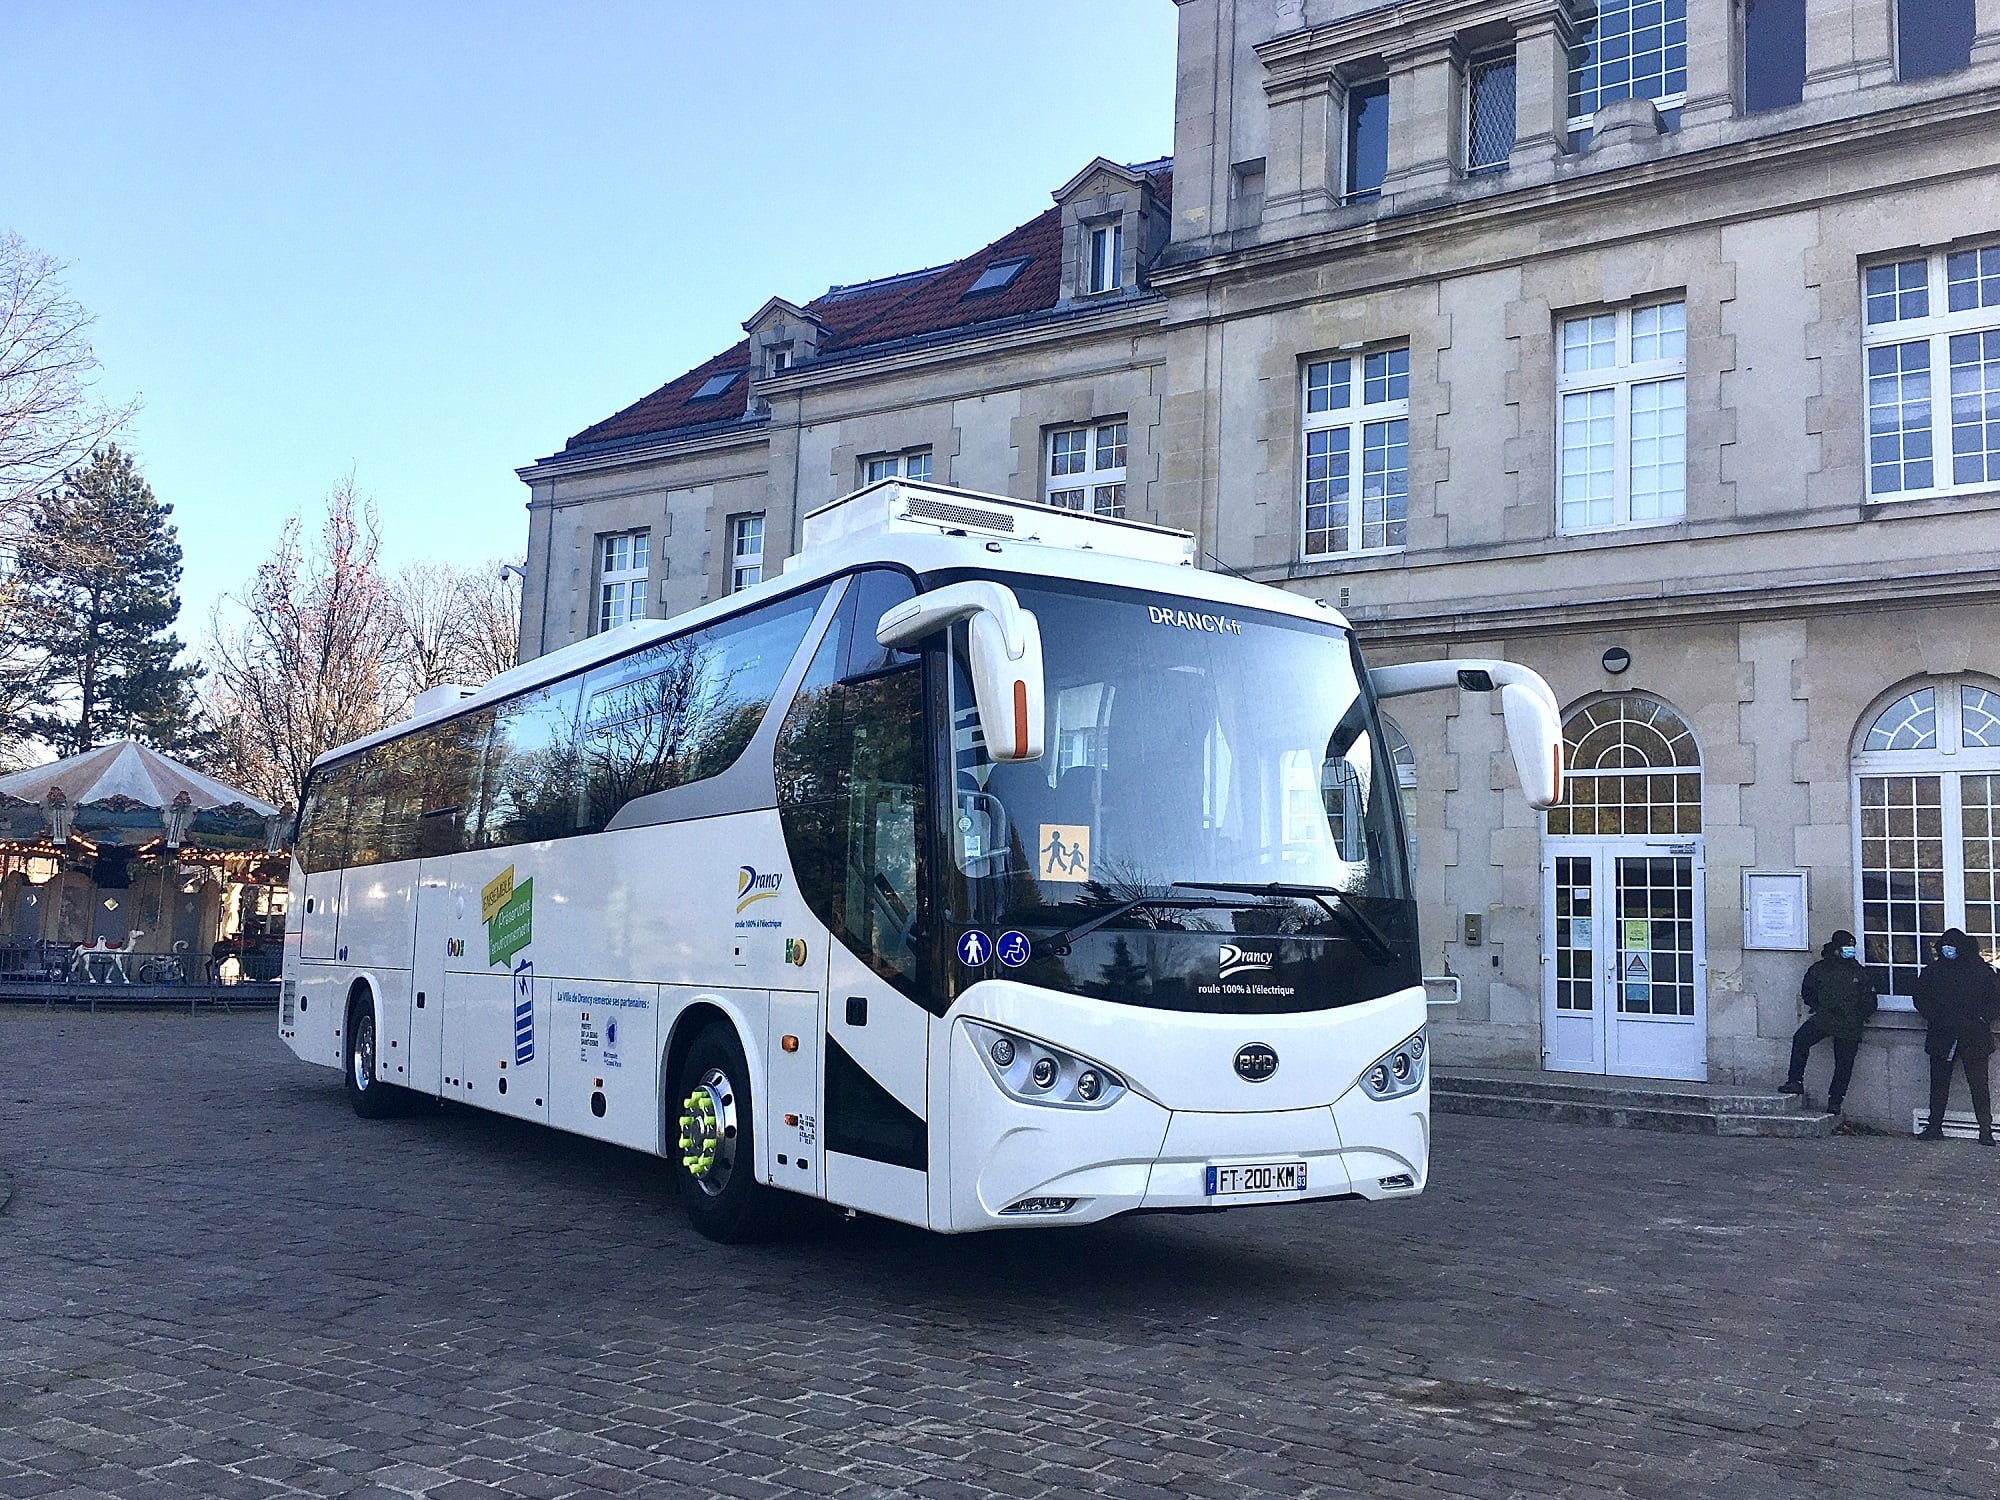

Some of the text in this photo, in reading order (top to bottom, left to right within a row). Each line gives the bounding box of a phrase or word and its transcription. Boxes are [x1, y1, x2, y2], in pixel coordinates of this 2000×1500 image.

[737, 865, 783, 899] Drancy
[1219, 944, 1273, 969] Drancy
[1198, 983, 1295, 997] roule 100% à l'électrique
[578, 993, 593, 1006] Drancy
[1239, 1054, 1273, 1070] BYD
[1297, 1176, 1306, 1187] 93
